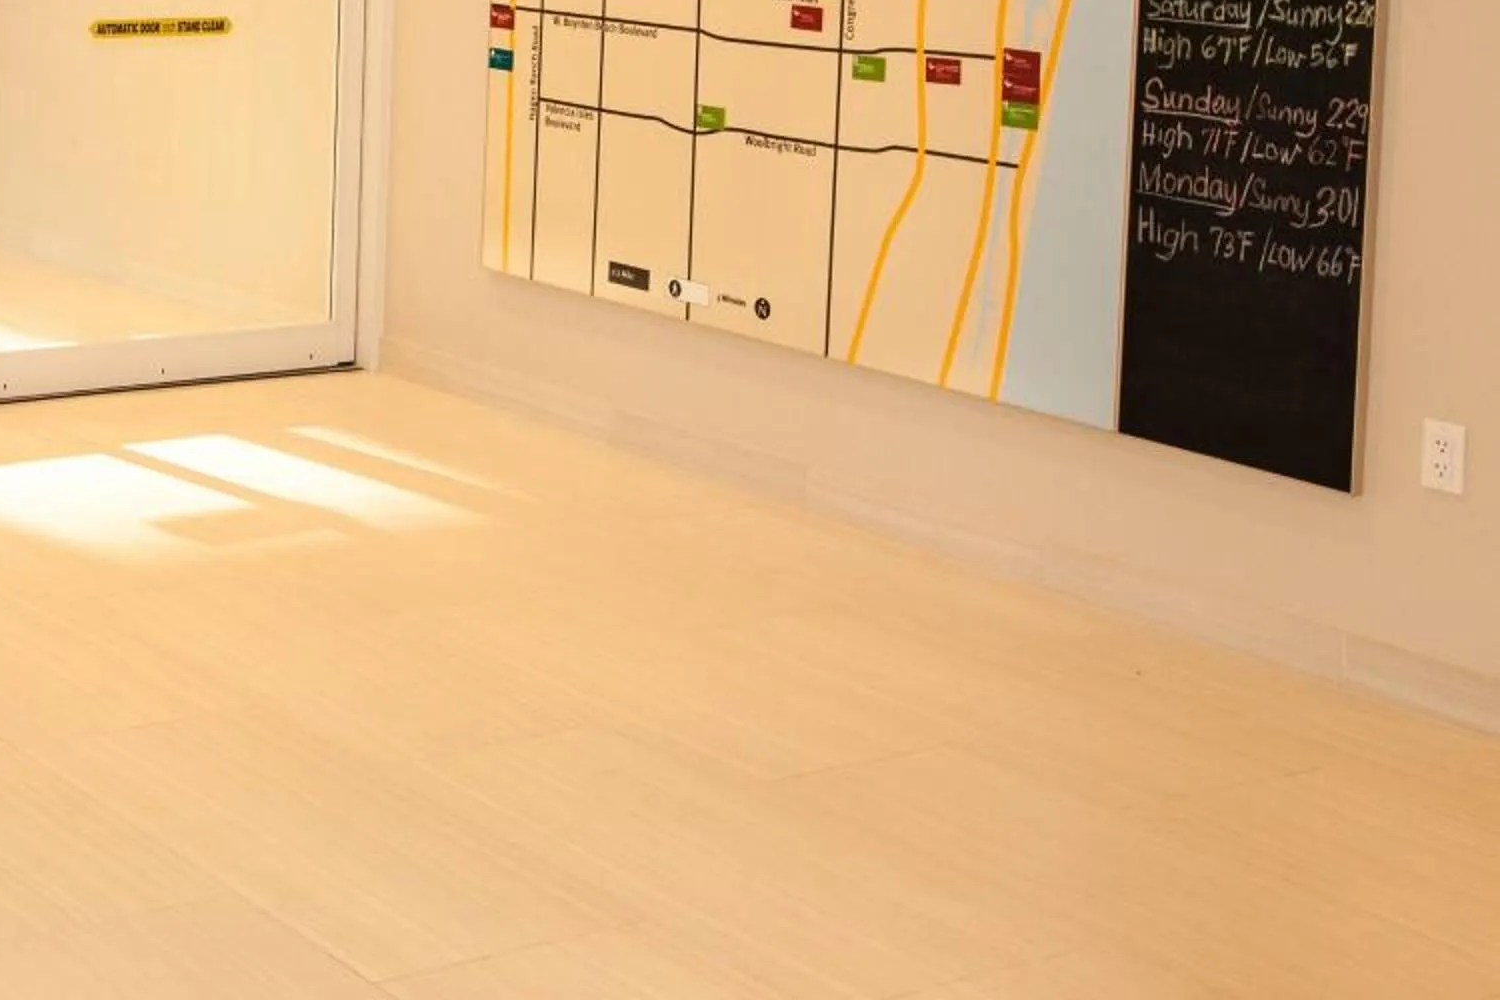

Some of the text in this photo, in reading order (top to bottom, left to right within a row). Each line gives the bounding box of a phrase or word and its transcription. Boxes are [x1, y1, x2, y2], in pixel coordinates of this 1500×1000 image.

[1143, 26, 1192, 69] High
[1141, 76, 1242, 126] Sunday
[1325, 97, 1369, 135] 2.29
[1142, 119, 1193, 159] High
[1136, 160, 1238, 217] Monday
[1308, 186, 1360, 229] 3.01
[1137, 204, 1199, 262] High
